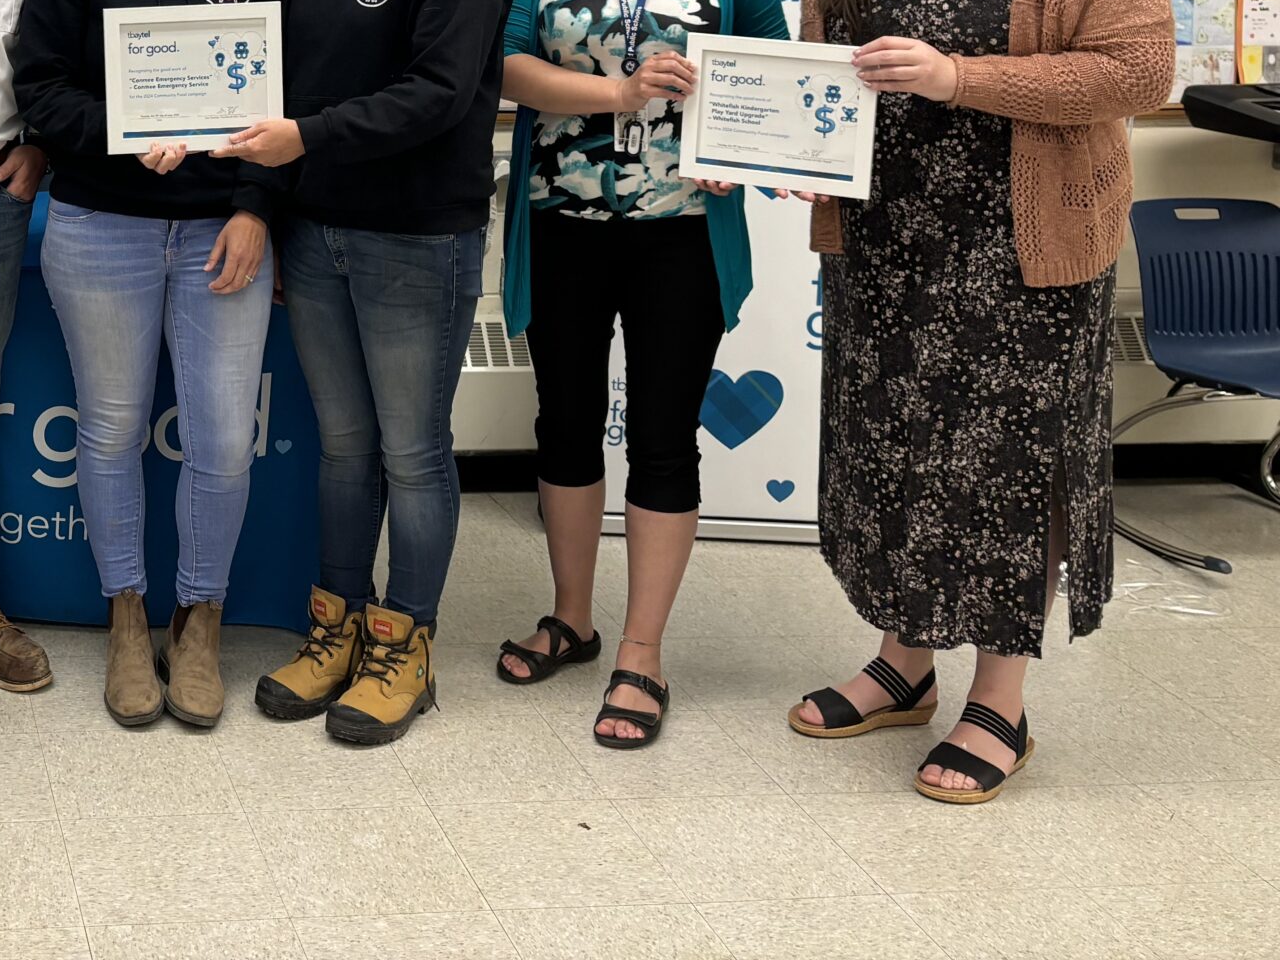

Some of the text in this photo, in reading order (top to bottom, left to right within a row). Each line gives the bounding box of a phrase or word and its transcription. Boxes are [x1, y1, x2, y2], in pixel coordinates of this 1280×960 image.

[128, 30, 151, 40] tbaytel
[128, 42, 144, 54] for
[712, 58, 736, 68] tbaytel
[711, 70, 728, 82] for
[158, 82, 188, 90] Emergency
[711, 108, 724, 116] Play
[740, 104, 780, 114] Kindergarten
[712, 116, 740, 124] Whitefish
[741, 118, 761, 126] School
